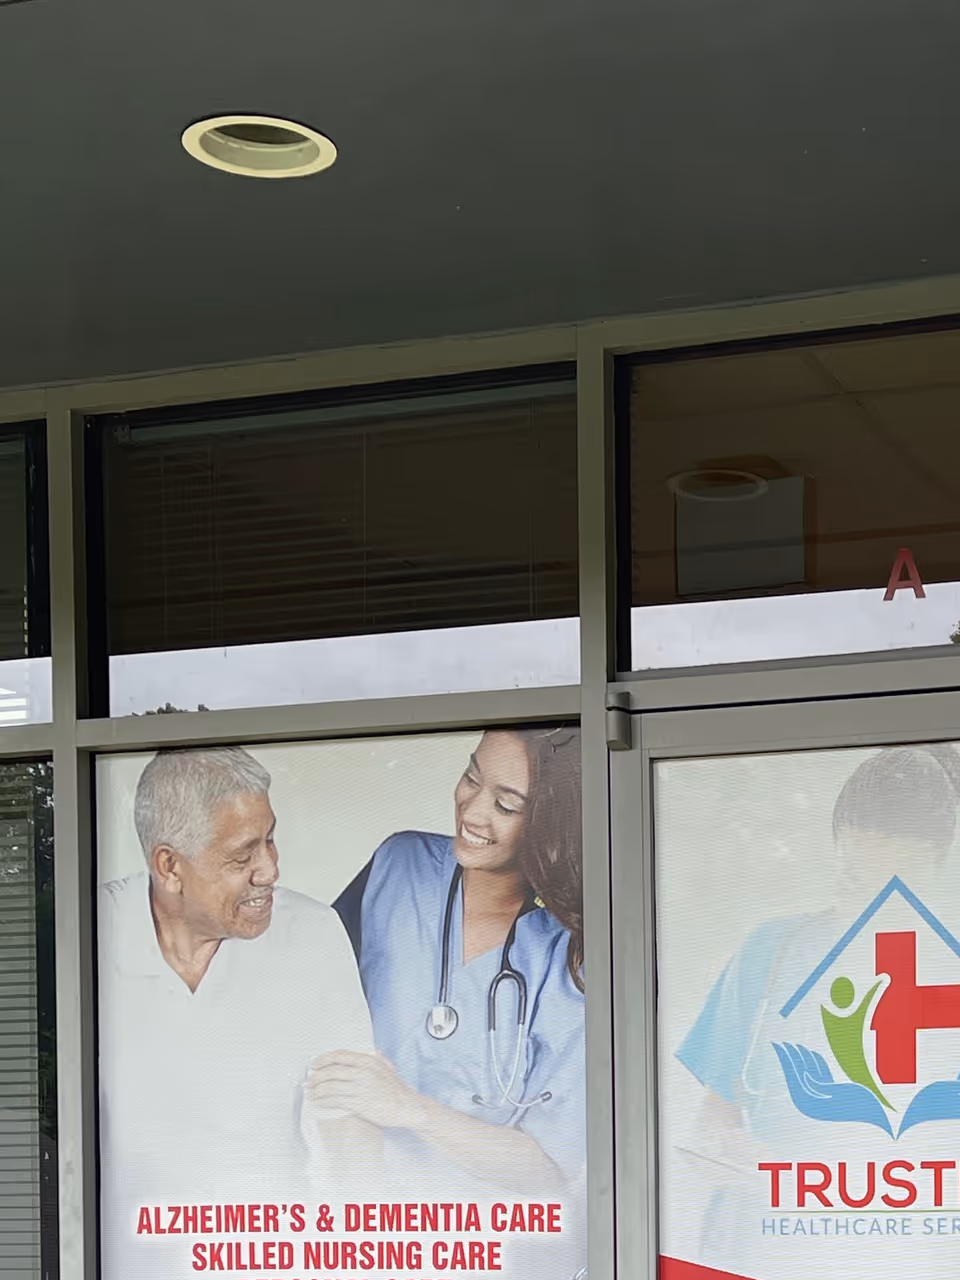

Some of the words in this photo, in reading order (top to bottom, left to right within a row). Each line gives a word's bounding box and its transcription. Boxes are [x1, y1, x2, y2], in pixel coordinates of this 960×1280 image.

[883, 547, 926, 601] A
[137, 1203, 306, 1235] ALZHEIMER’S
[316, 1204, 335, 1233] &
[344, 1203, 482, 1233] DEMENTIA
[490, 1202, 562, 1233] CARE
[761, 1217, 912, 1237] HEALTHCARE
[192, 1241, 295, 1271] SKILLED
[303, 1240, 423, 1271] NURSING
[432, 1240, 503, 1271] CARE
